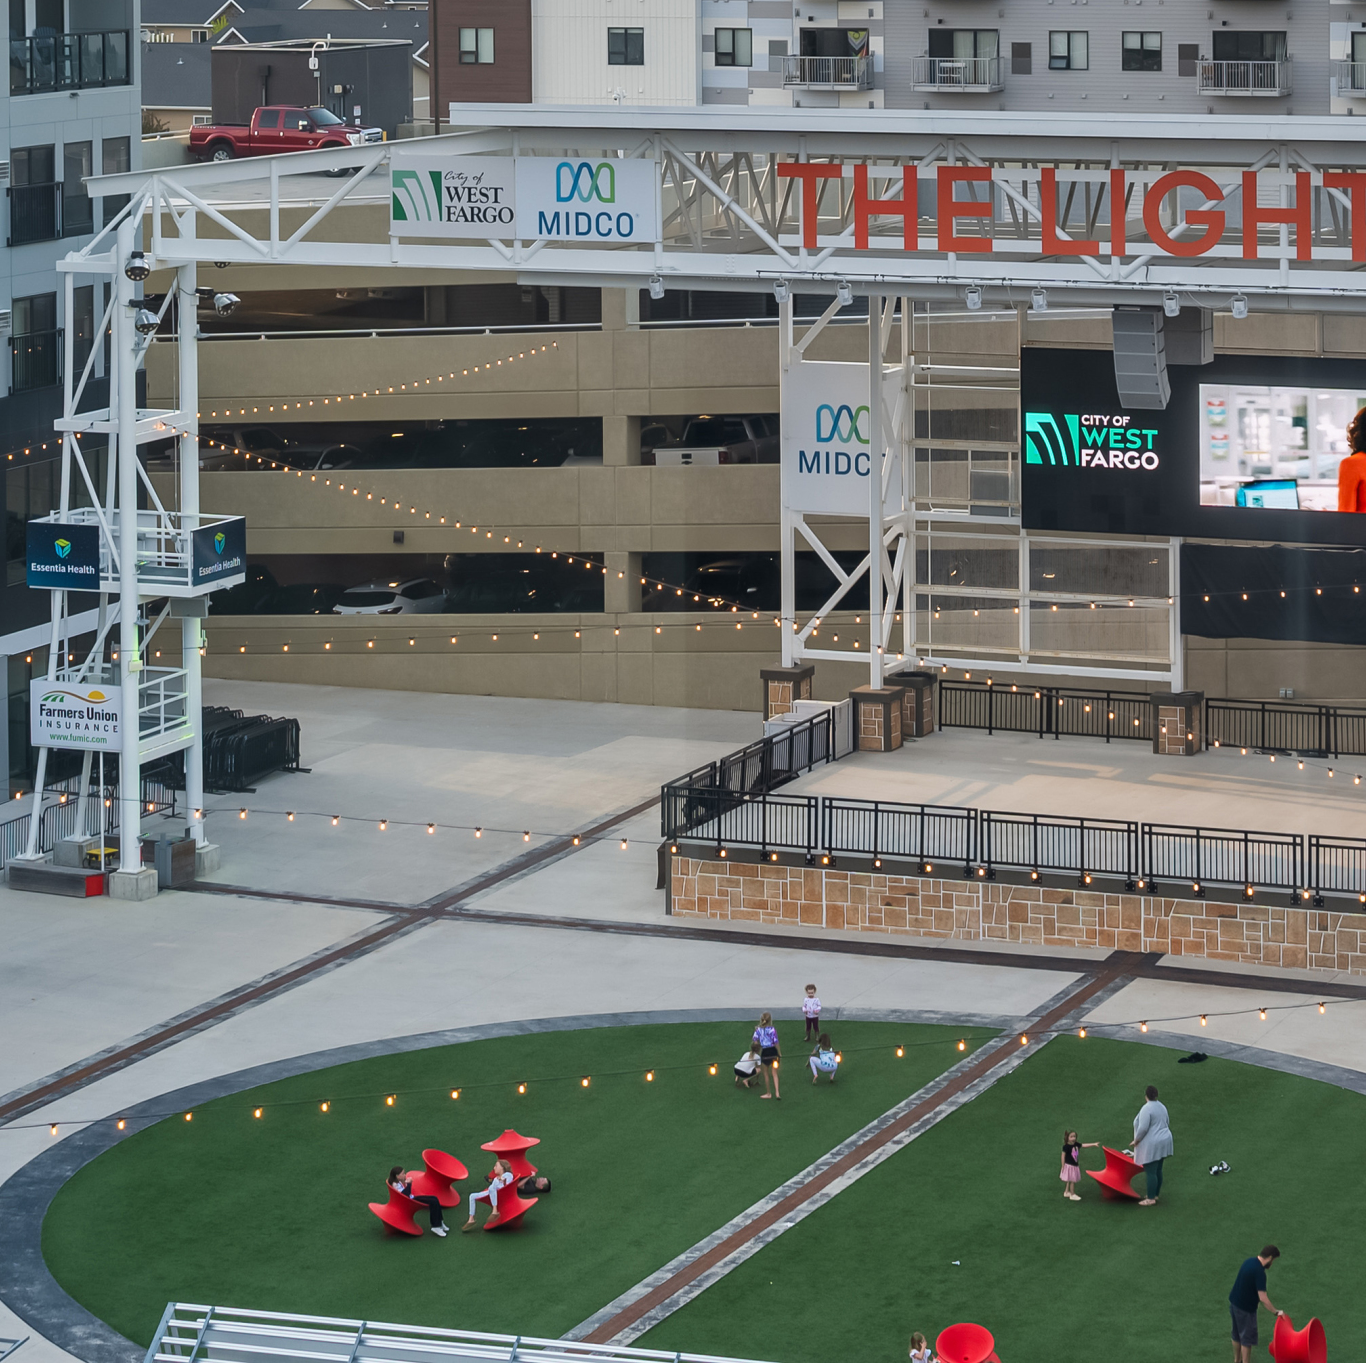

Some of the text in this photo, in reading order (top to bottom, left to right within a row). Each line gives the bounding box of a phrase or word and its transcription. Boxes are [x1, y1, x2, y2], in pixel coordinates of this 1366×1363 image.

[444, 170, 485, 186] City of
[445, 186, 504, 204] WEST
[445, 205, 515, 224] FARGO
[777, 163, 993, 253] THE
[538, 211, 634, 237] MIDCO
[1081, 415, 1131, 426] CITY OF
[1081, 427, 1158, 450] WEST
[799, 450, 871, 477] MIDC
[1081, 449, 1159, 470] FARGO
[31, 563, 95, 575] Essentia Health
[198, 556, 241, 577] Essentia Health
[39, 703, 118, 722] Farmers Union
[39, 719, 119, 733] INSURANCE
[49, 733, 108, 744] www.fumic.com
